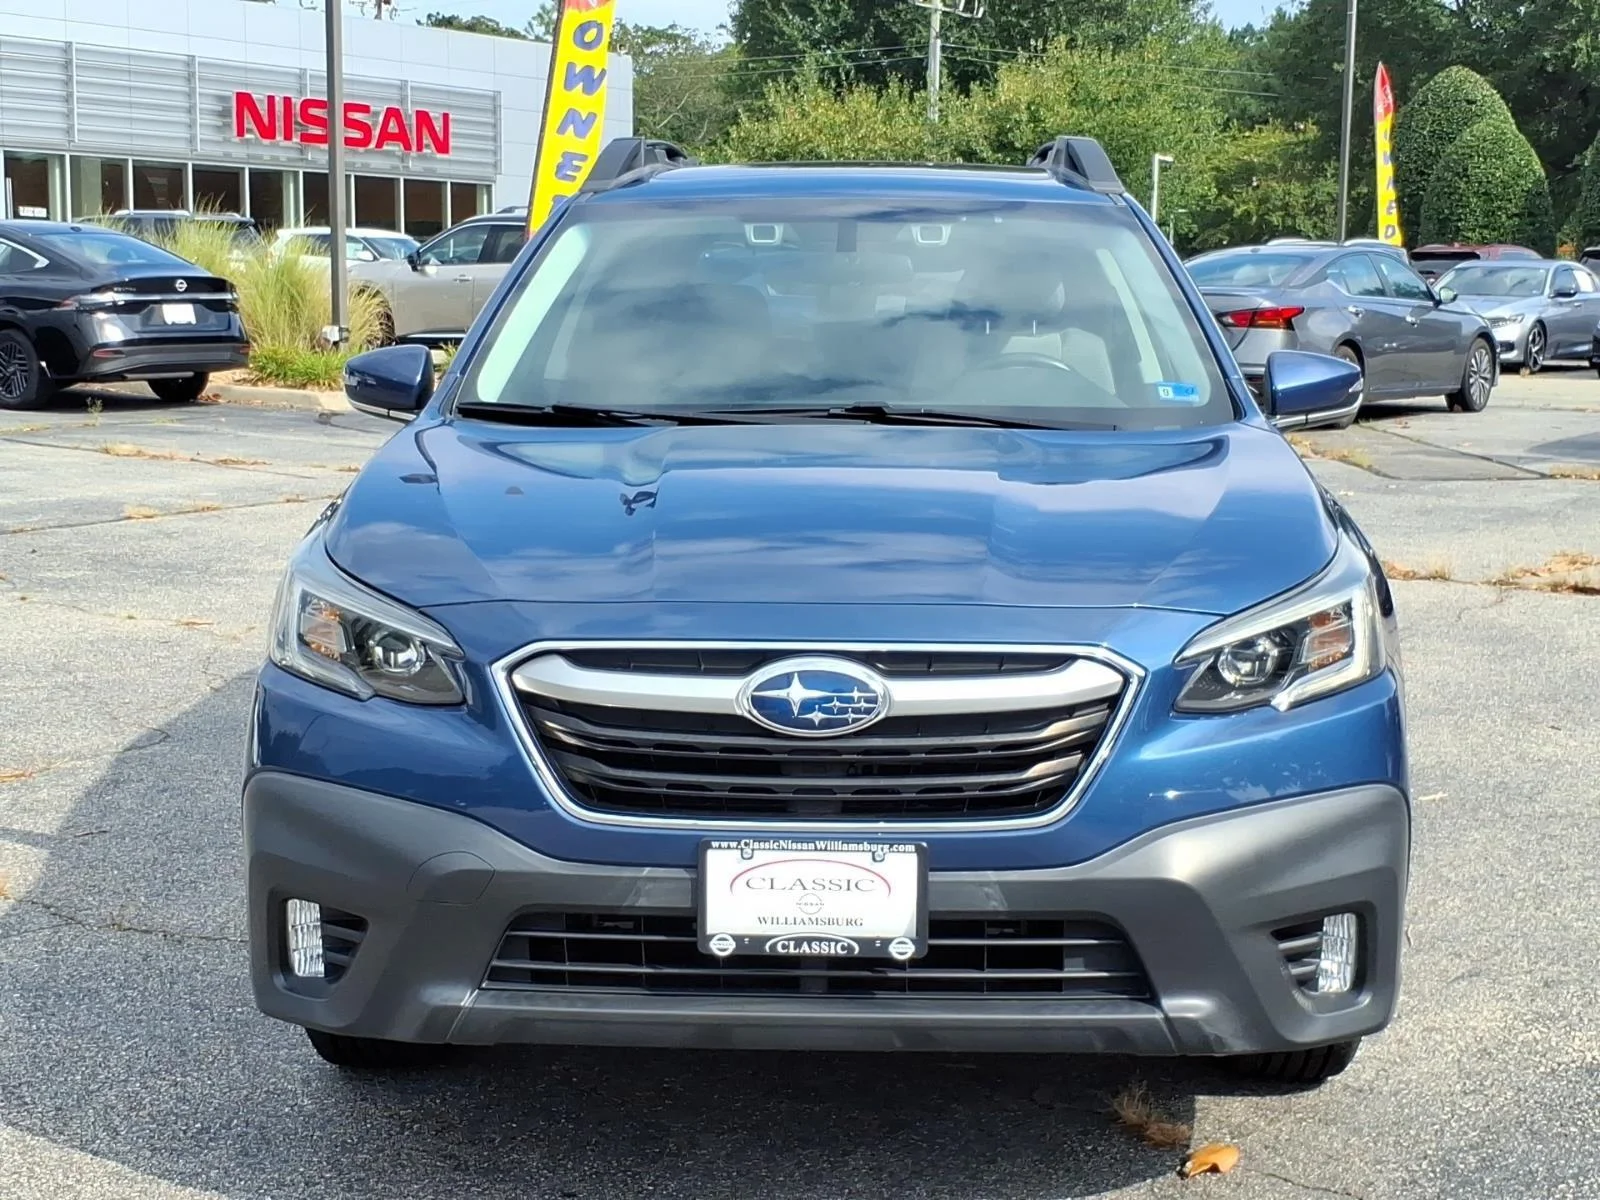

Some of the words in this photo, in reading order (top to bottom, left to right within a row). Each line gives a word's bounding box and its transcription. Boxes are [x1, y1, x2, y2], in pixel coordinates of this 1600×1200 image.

[234, 91, 450, 155] NISSAN
[711, 839, 916, 853] www.ClassicNissanWilliamsburg.com
[745, 876, 875, 892] CLASSIC
[757, 915, 864, 927] WILLIAMSBURG
[776, 940, 849, 955] CLASSIC
